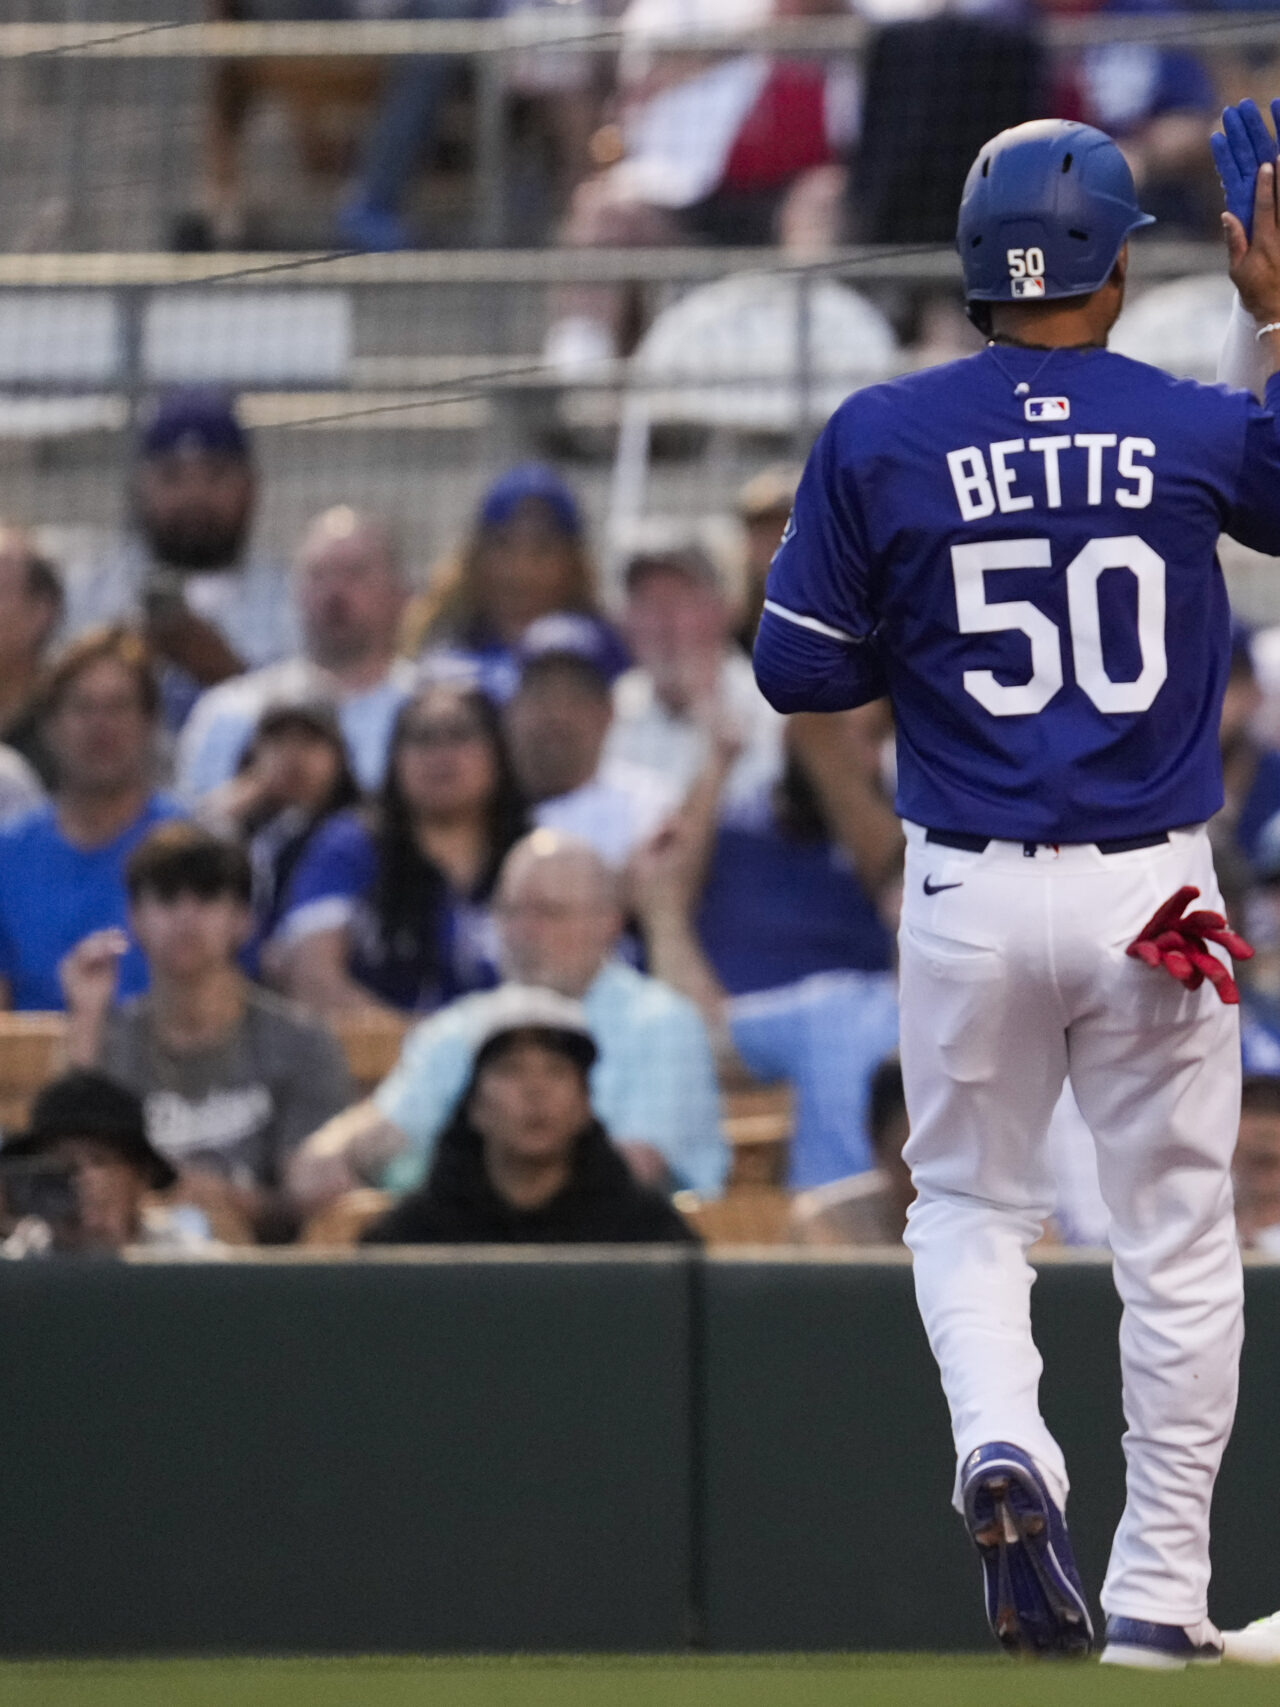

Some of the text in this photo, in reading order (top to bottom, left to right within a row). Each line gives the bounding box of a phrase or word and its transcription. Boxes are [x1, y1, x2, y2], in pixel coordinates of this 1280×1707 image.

[1006, 247, 1046, 278] 50
[946, 433, 1156, 522] BETTS
[951, 535, 1168, 716] 50
